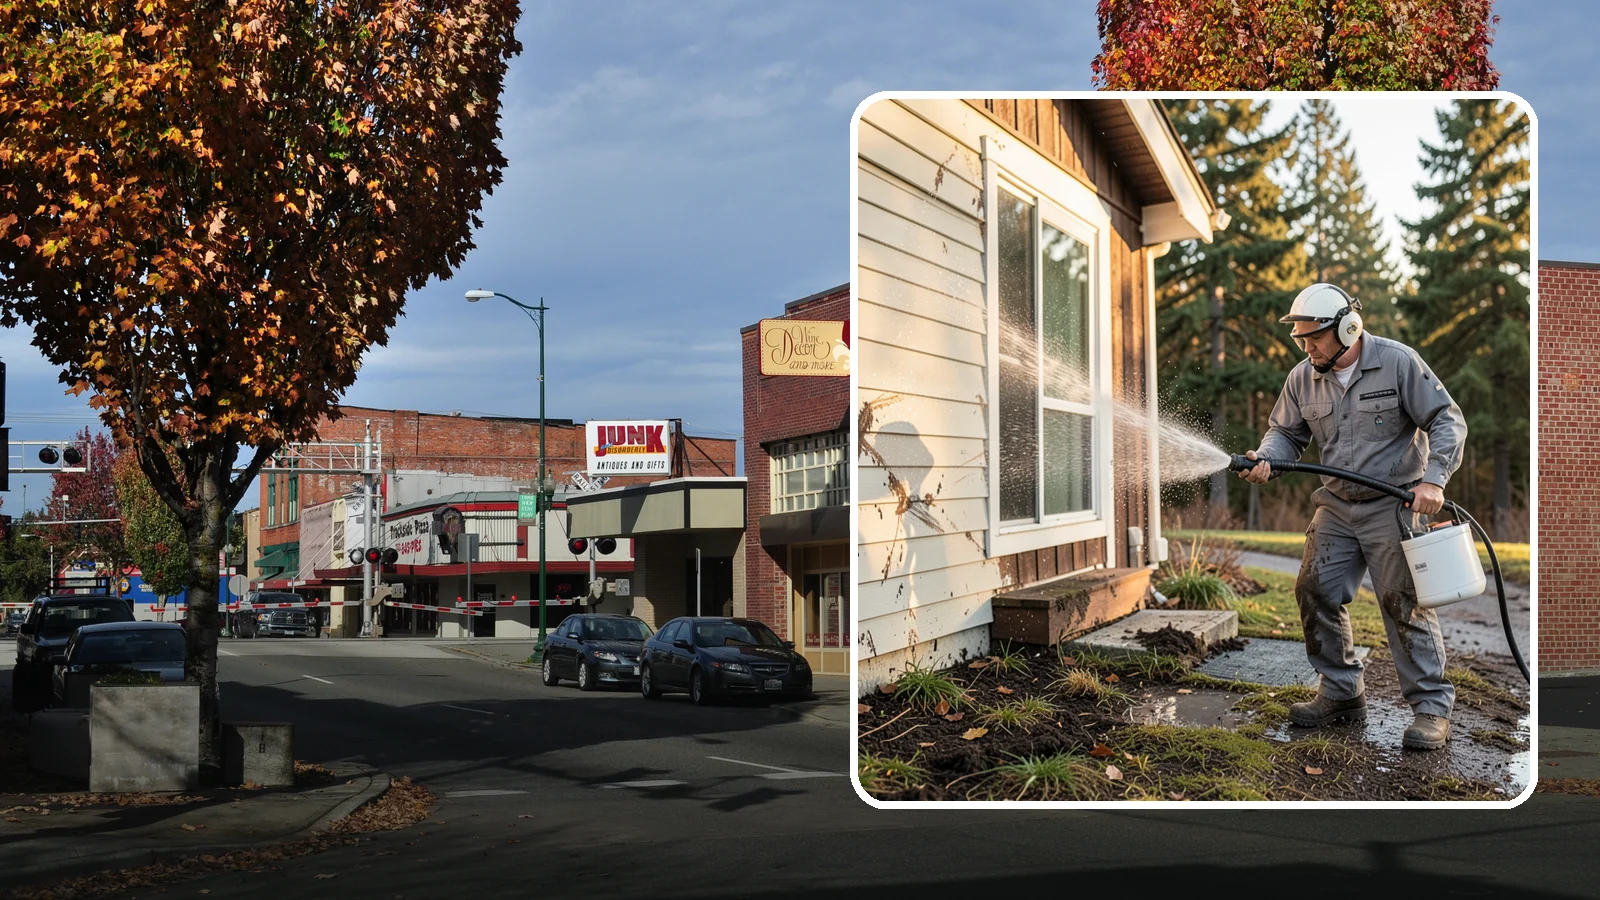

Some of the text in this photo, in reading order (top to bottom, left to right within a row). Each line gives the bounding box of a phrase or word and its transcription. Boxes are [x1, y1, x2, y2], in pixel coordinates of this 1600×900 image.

[595, 425, 665, 457] JUNK
[607, 446, 646, 454] DISORDERLY
[597, 460, 665, 470] ANTIQUES AND GIFTS
[353, 498, 364, 510] CRO
[390, 520, 429, 539] Trackside Pizza
